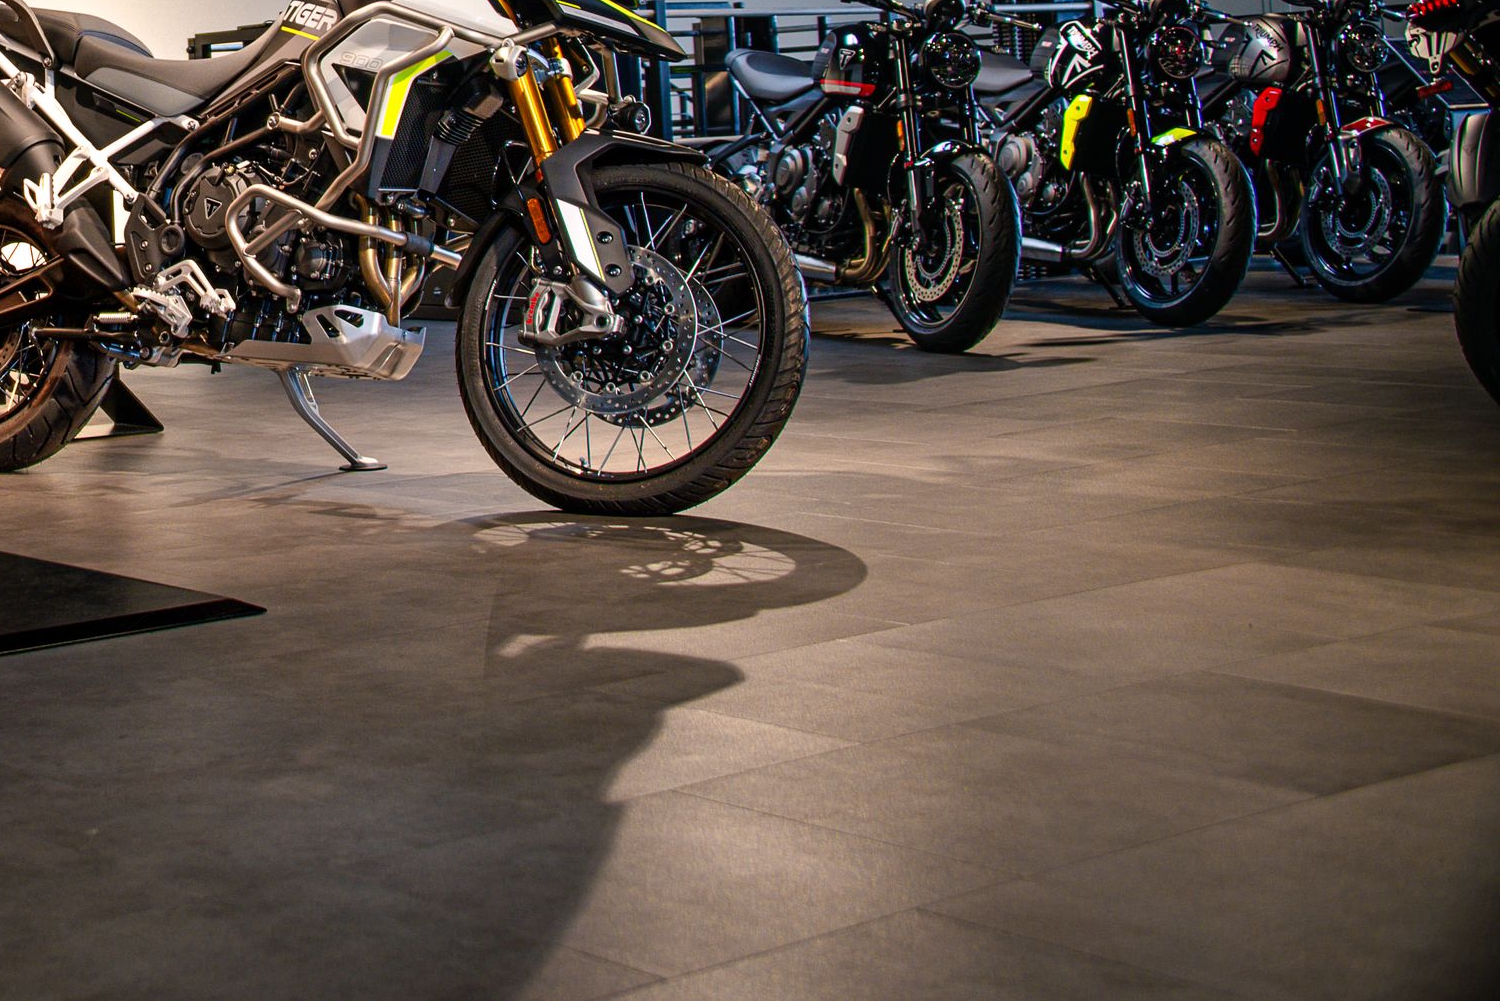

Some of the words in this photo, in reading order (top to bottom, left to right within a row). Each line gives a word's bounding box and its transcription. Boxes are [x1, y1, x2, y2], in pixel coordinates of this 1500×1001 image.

[283, 0, 338, 32] TIGER
[1067, 25, 1099, 60] TRIUMPH
[1251, 22, 1284, 52] TRIUMPH
[340, 52, 384, 73] 900
[526, 292, 540, 325] brembo
